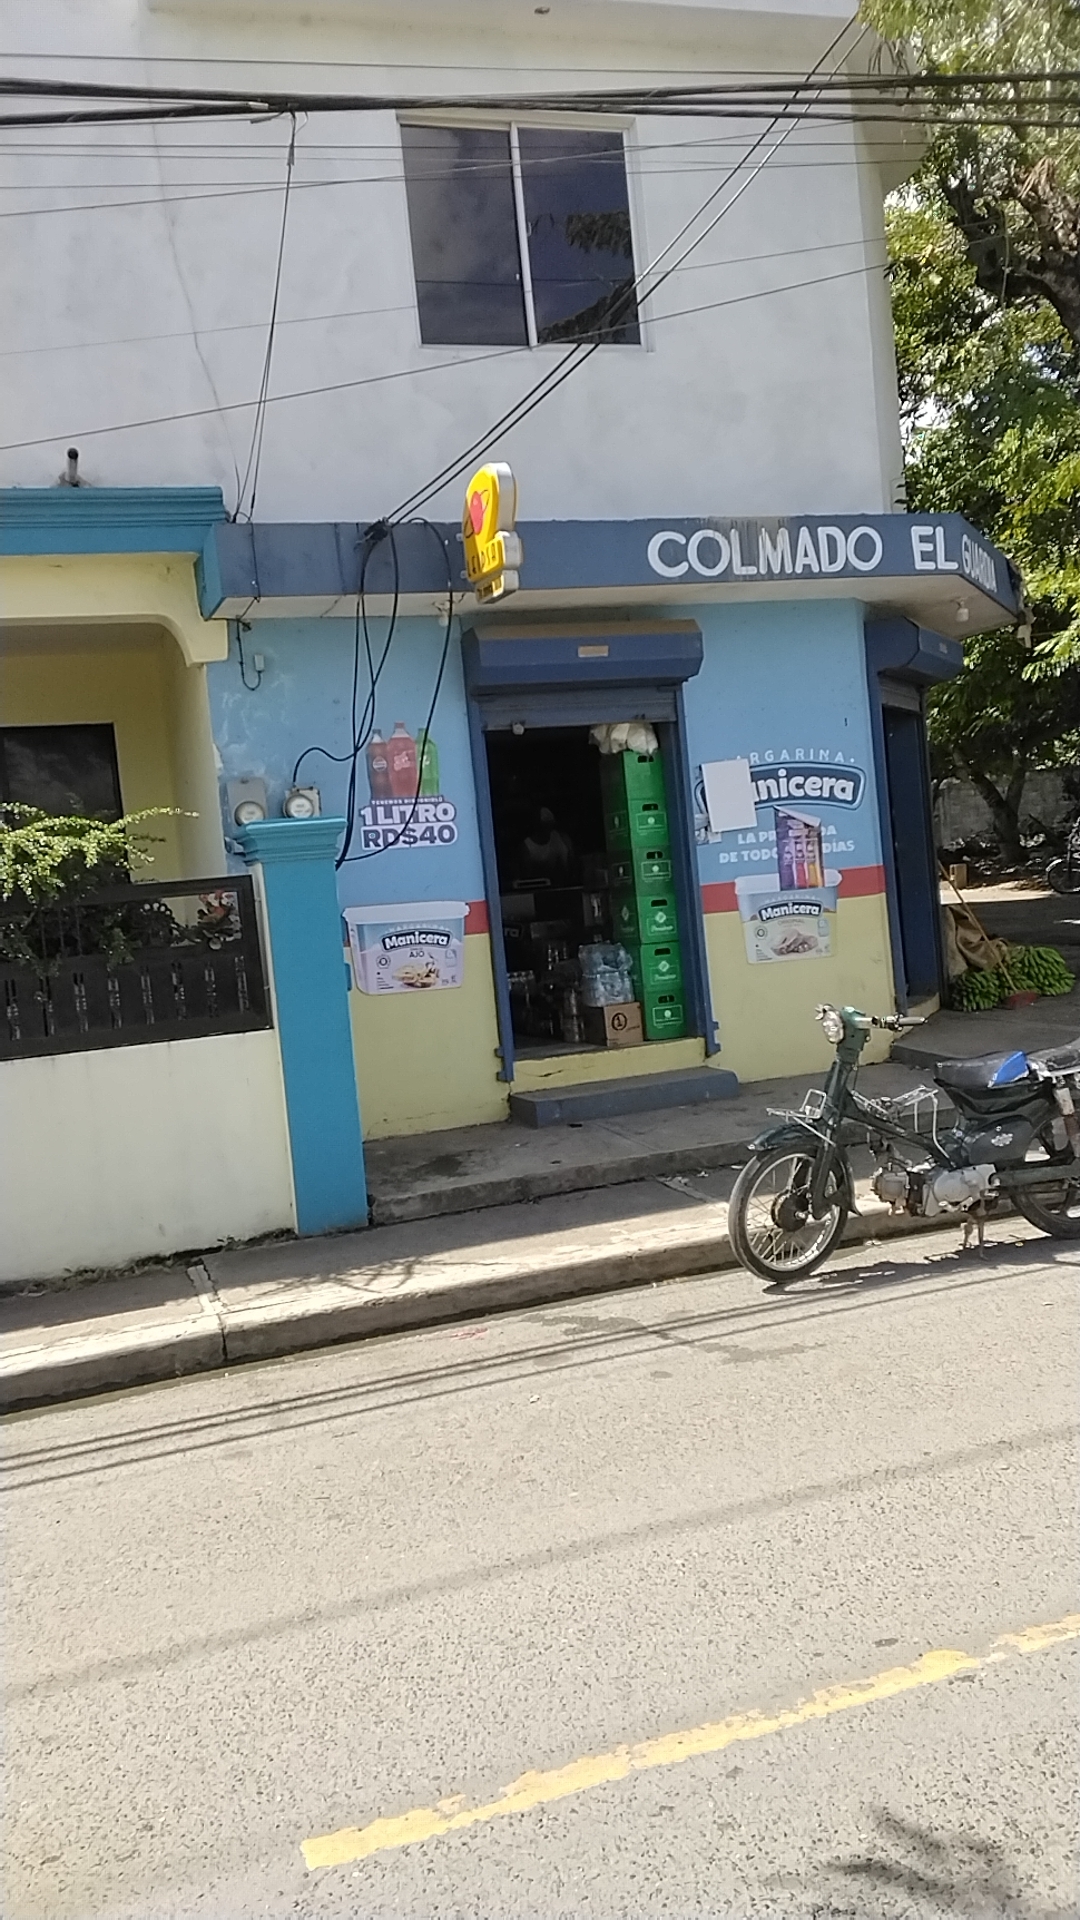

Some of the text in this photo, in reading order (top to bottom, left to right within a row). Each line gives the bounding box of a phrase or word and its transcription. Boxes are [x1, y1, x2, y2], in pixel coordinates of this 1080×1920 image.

[647, 525, 883, 577] COLMADO
[911, 525, 959, 570] EL
[736, 747, 846, 765] RGARINA
[751, 768, 855, 802] nicera
[360, 802, 455, 826] 1 LITRO
[362, 824, 456, 848] RD$40
[737, 832, 757, 845] LA
[719, 852, 738, 864] DE
[822, 838, 855, 854] DÍAS
[760, 902, 820, 921] Manicera
[384, 931, 448, 950] Manicera
